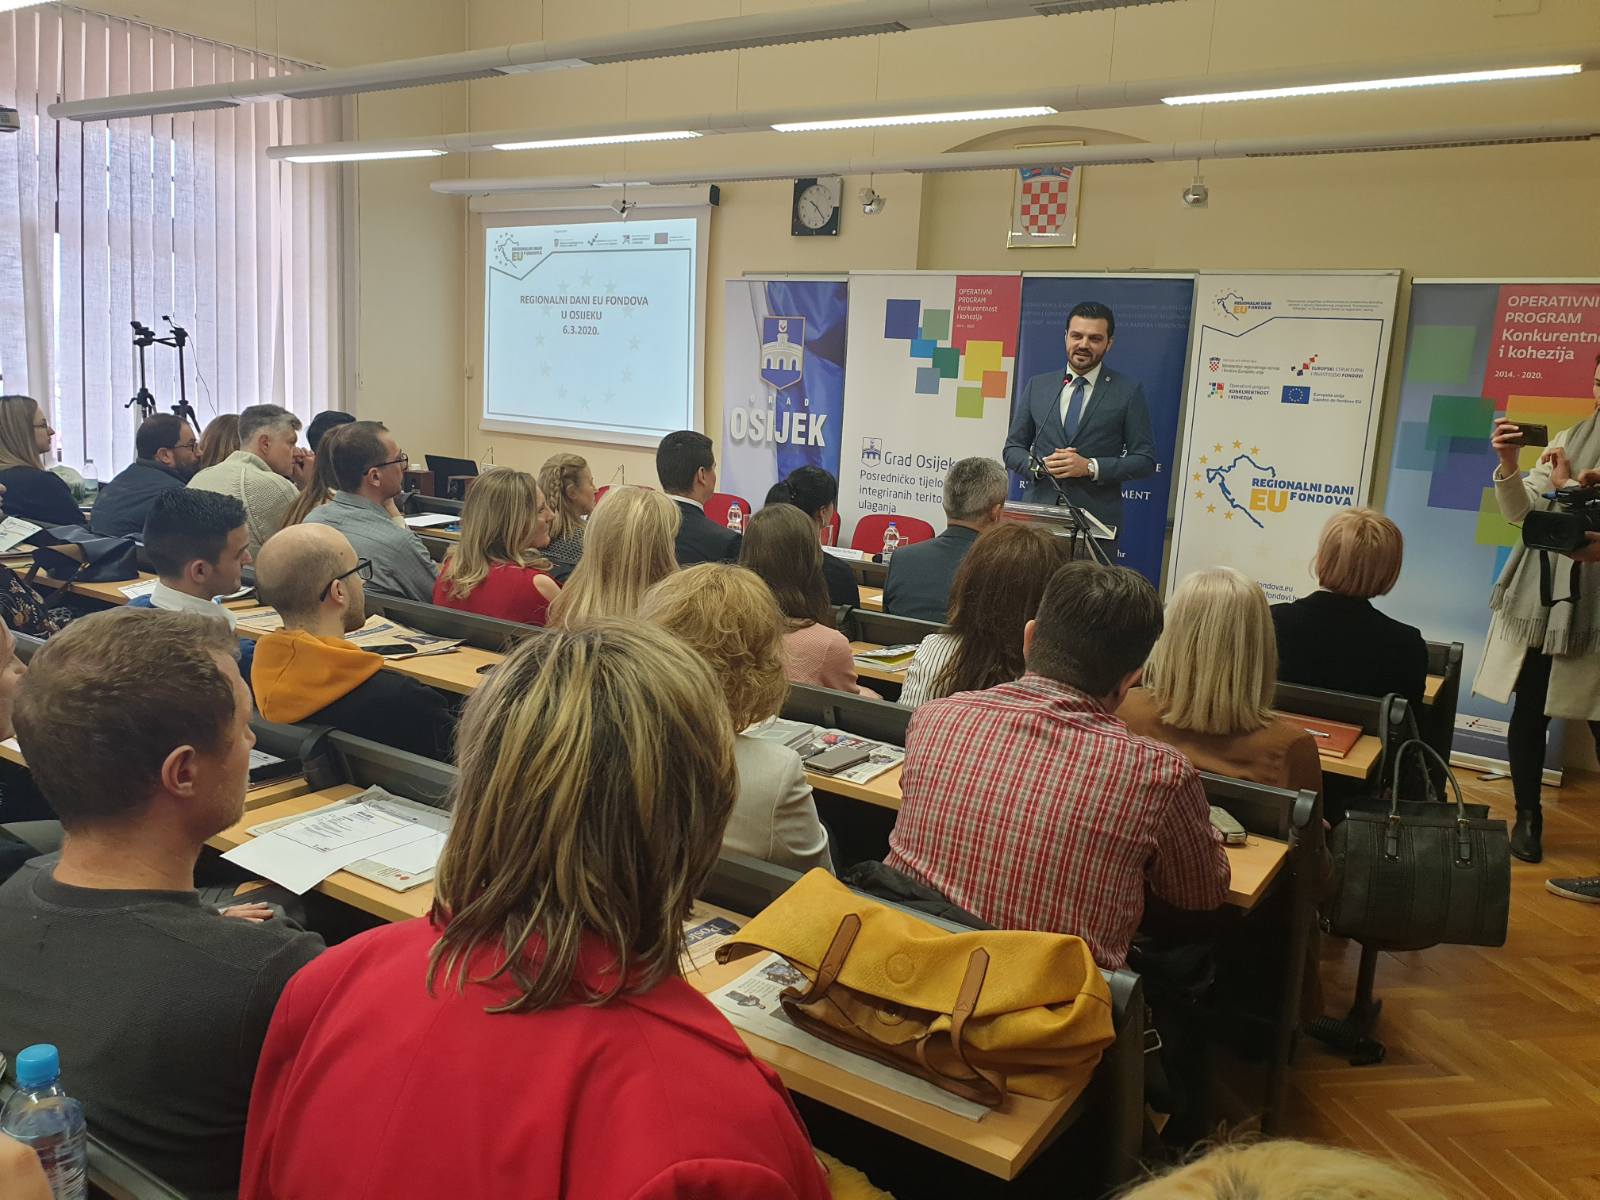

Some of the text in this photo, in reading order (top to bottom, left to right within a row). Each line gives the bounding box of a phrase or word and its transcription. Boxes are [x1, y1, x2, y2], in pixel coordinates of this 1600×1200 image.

[520, 295, 648, 305] REGIONALNI DANI EU FONDOVA
[1507, 295, 1600, 308] OPERATIVNI
[561, 310, 602, 320] U OSIJEKU
[1232, 305, 1248, 314] EU
[1505, 312, 1582, 324] PROGRAM
[562, 325, 600, 335] 6.3.2020.
[1502, 328, 1600, 342] Konkurentn
[1499, 345, 1574, 363] i kohezija
[730, 407, 828, 447] OSIJEK
[884, 452, 956, 472] Grad Osijek
[860, 469, 944, 488] Posredničko tijelo
[860, 484, 944, 504] integriranih terito
[1252, 478, 1354, 496] REGIONALNI DANI
[858, 500, 897, 514] ulaganja
[1248, 488, 1352, 513] EU FONDOVA
